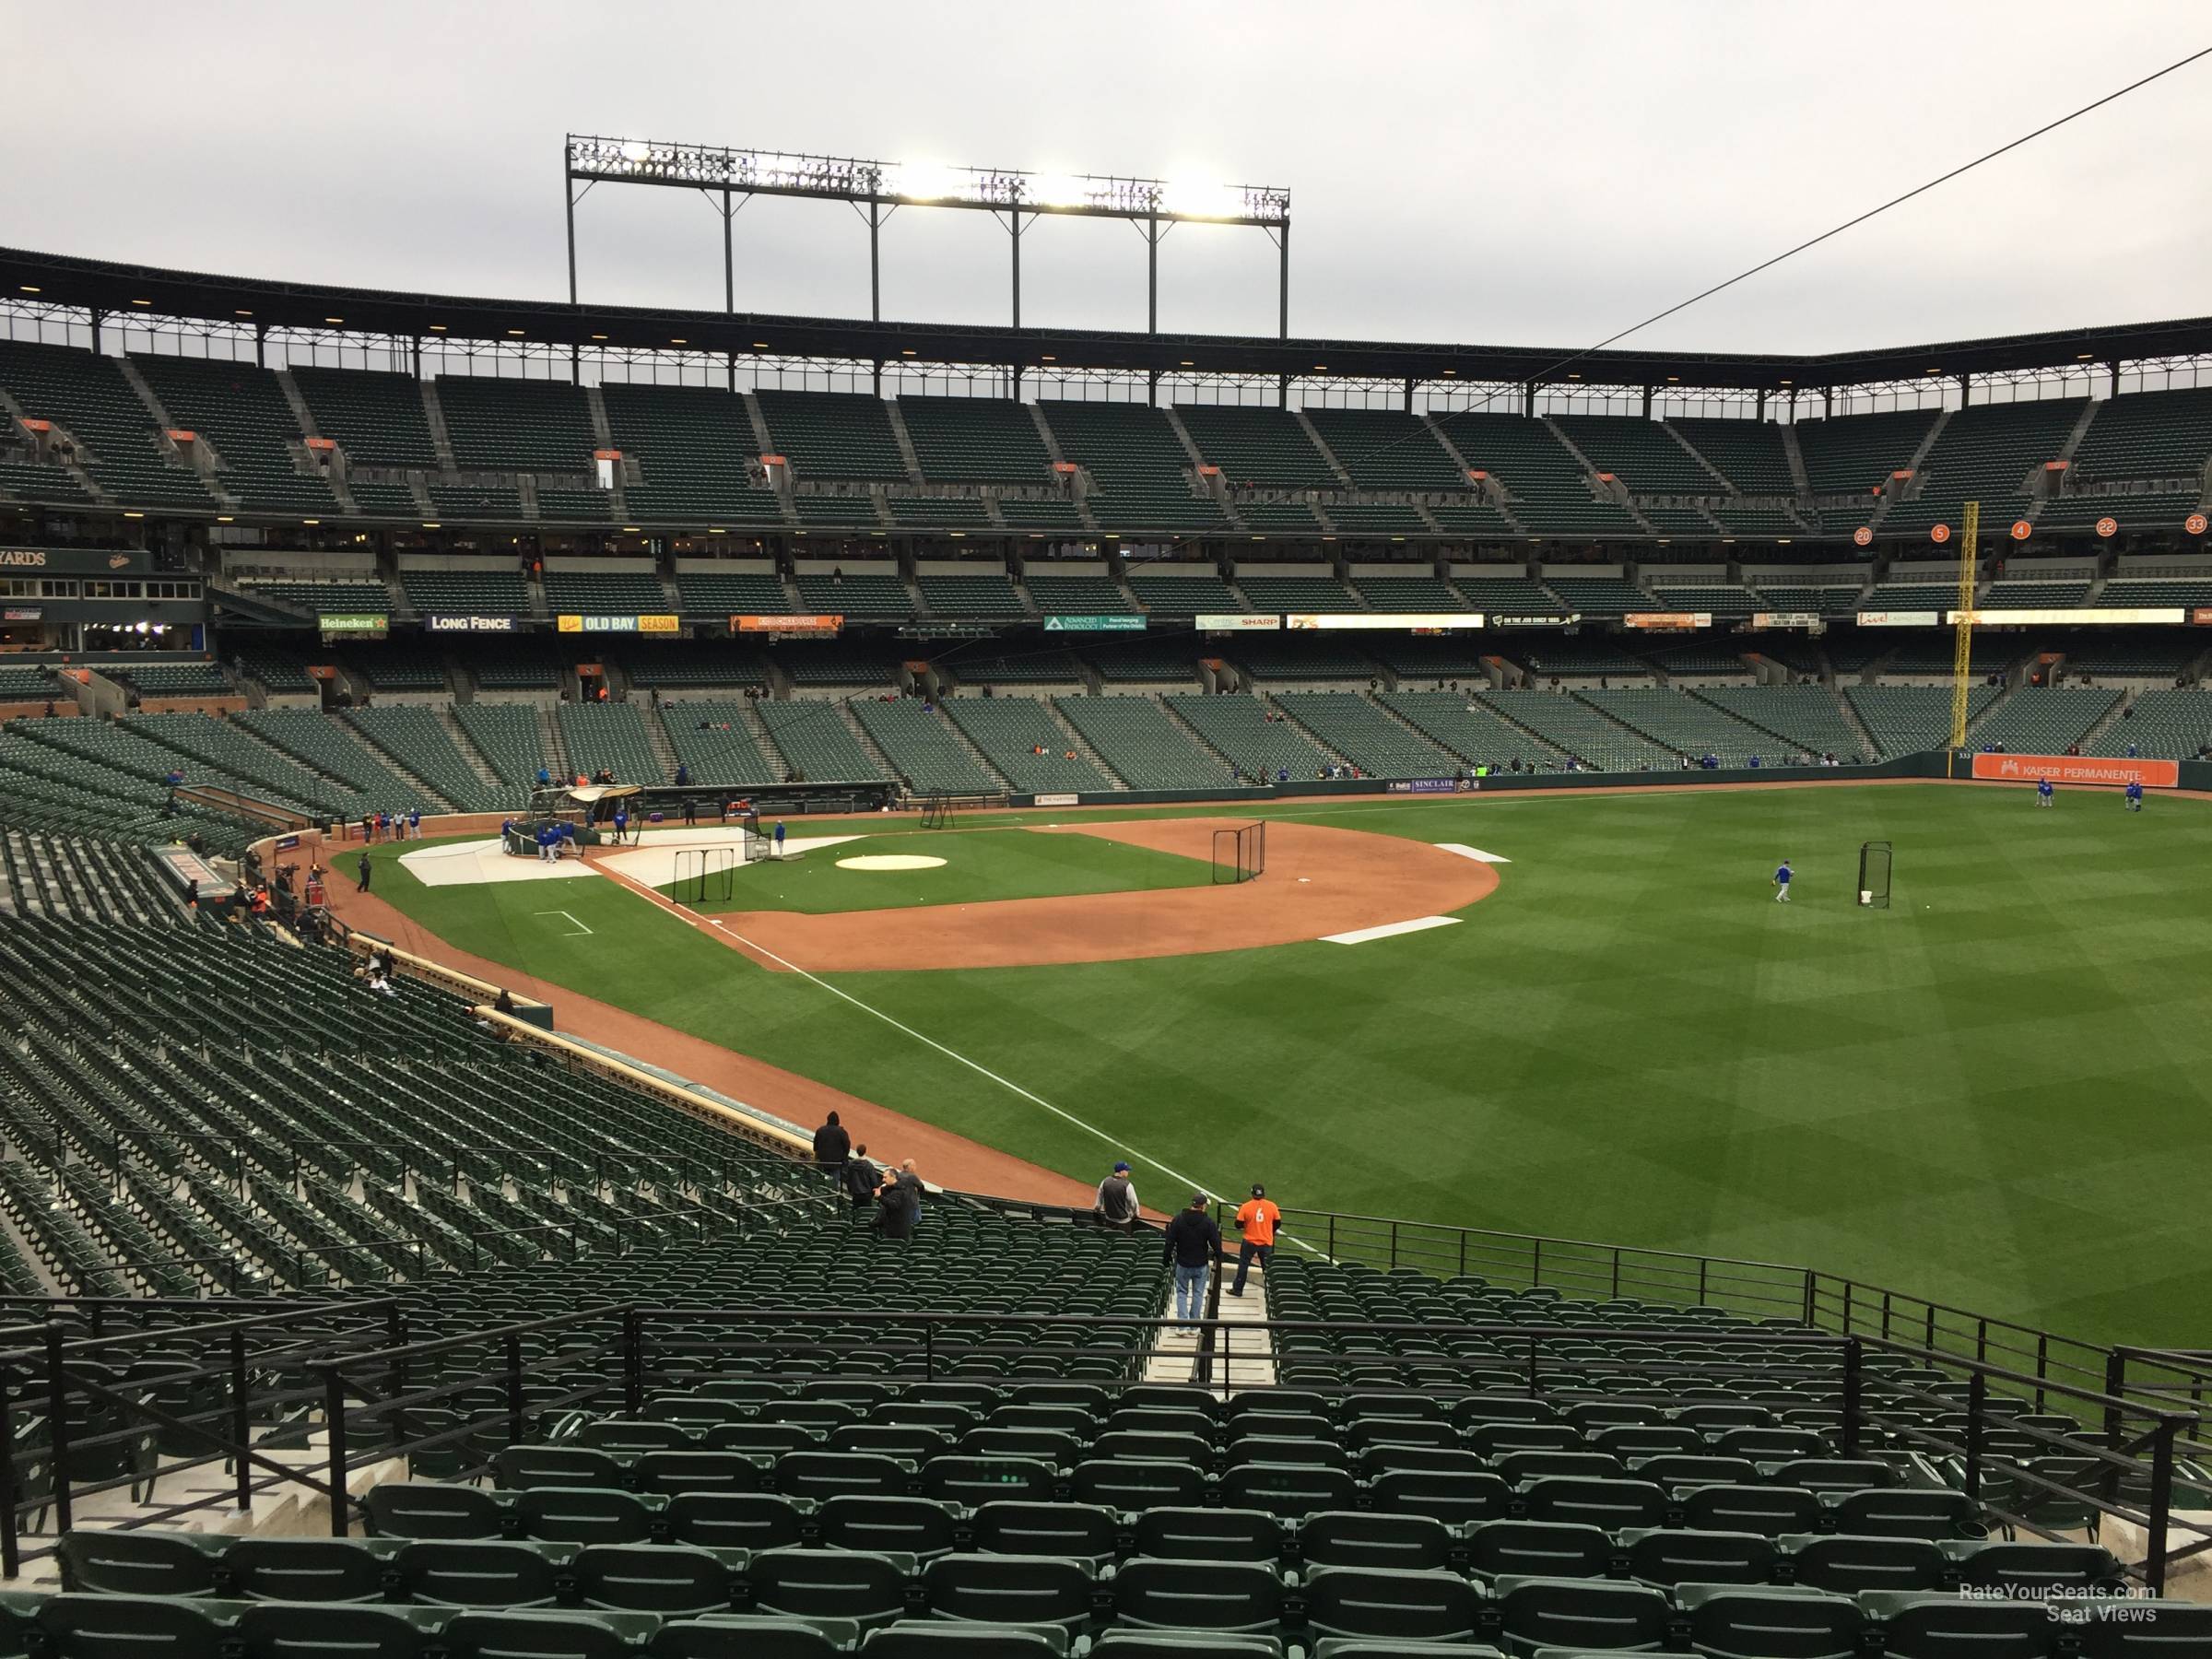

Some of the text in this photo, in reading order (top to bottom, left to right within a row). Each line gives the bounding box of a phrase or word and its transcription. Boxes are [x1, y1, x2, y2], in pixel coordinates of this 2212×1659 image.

[2099, 522, 2114, 533] 22
[2188, 518, 2204, 530] 33
[1936, 528, 1945, 538] 5
[2017, 525, 2024, 535] 4
[1856, 531, 1871, 542] 20
[321, 618, 373, 629] Heineken
[432, 617, 512, 629] LONG FENCE
[585, 618, 634, 629] OLD BAY
[641, 618, 676, 629] SEASON
[2023, 766, 2143, 781] KAISER PERMANENTE
[1415, 780, 1454, 788] SINCLAIR
[1255, 1207, 1265, 1223] 6
